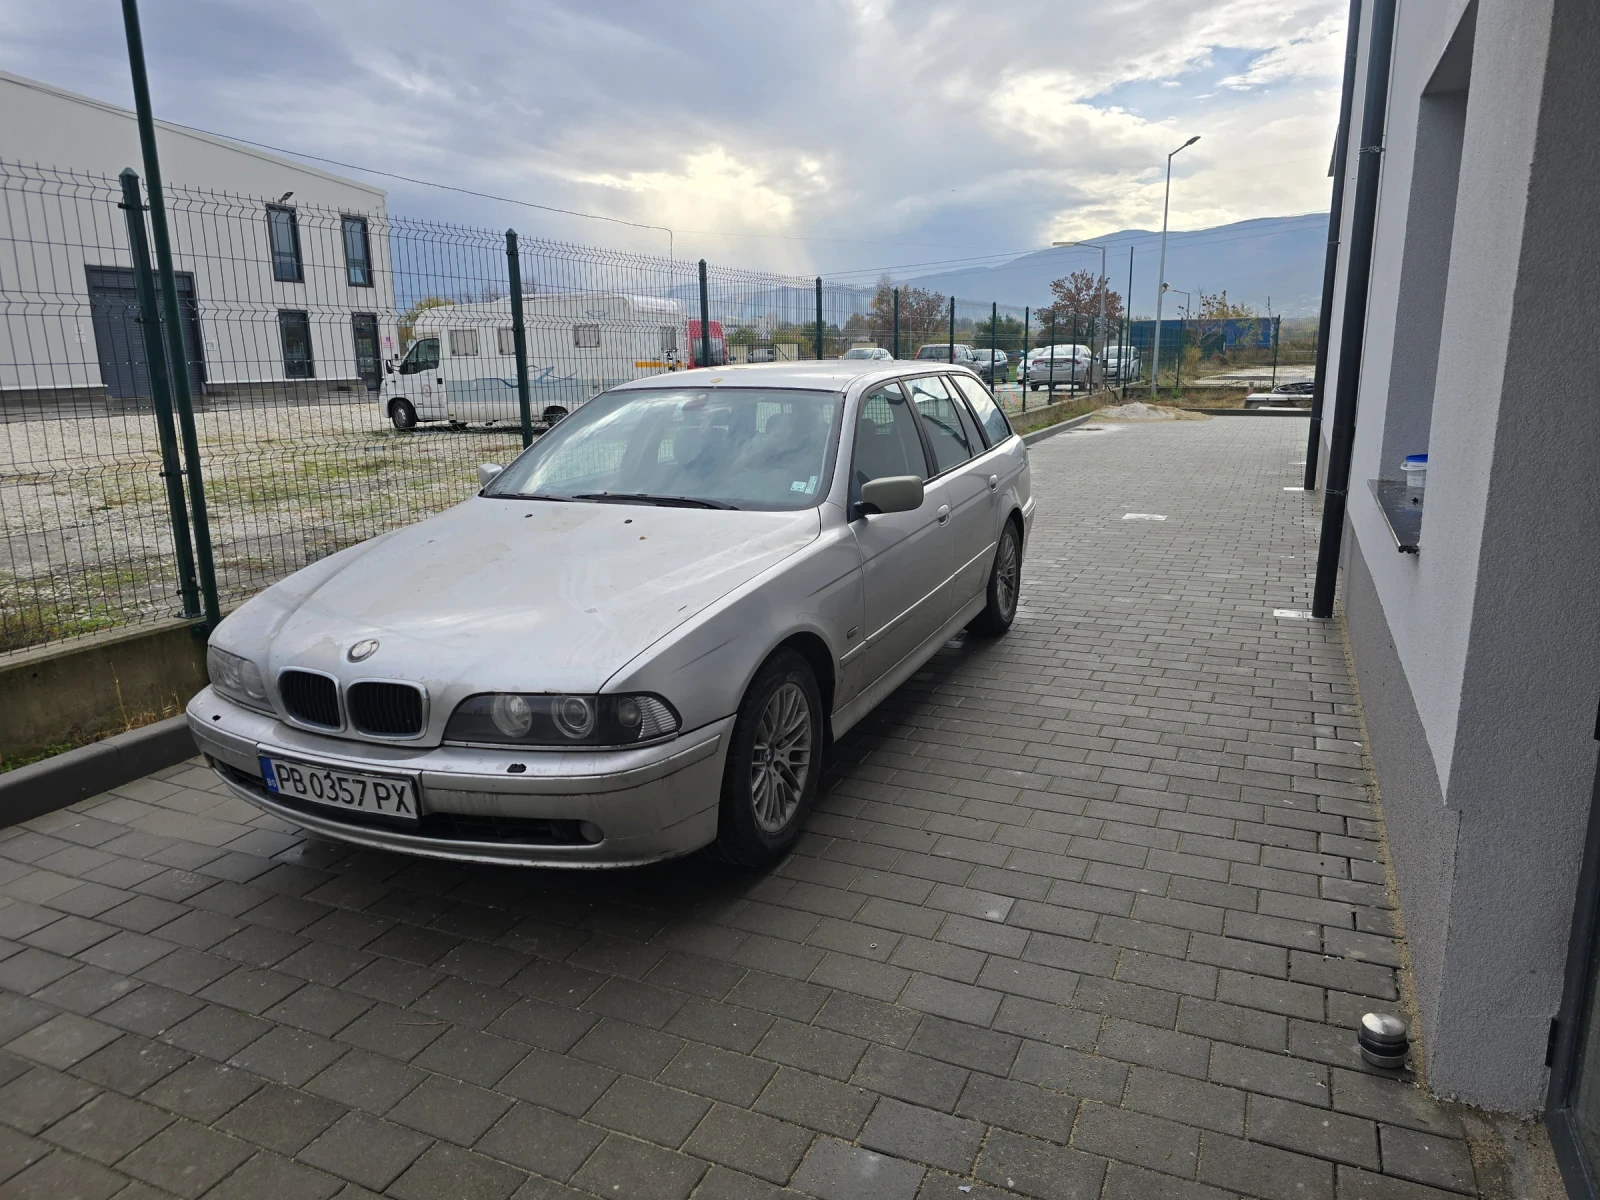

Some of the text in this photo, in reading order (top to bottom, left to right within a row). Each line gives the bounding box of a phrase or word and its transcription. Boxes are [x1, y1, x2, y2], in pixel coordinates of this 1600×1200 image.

[266, 777, 277, 788] BG
[275, 763, 411, 814] PB 0357 PX
